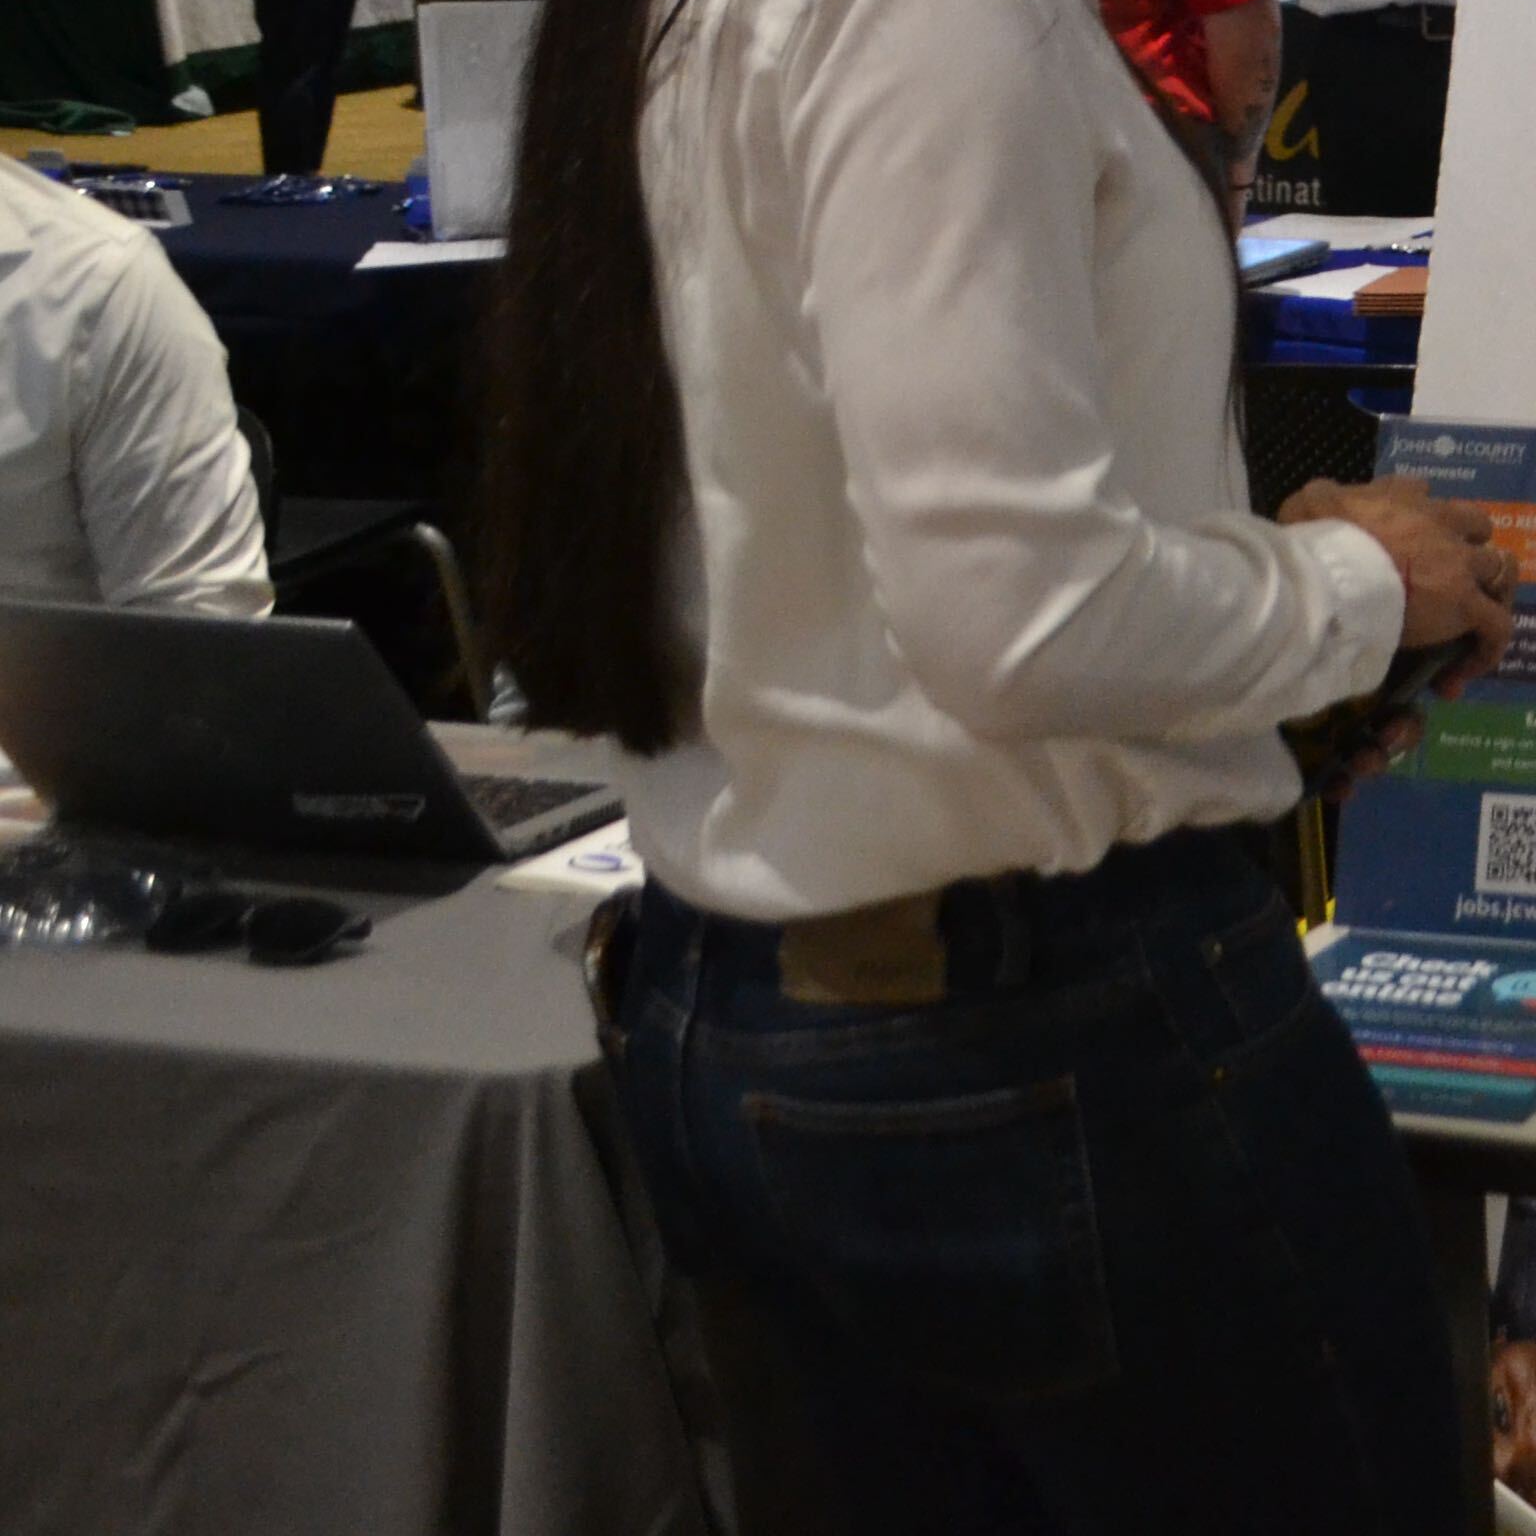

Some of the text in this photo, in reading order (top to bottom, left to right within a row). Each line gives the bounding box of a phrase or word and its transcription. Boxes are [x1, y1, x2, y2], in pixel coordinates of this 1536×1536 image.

[1361, 951, 1499, 978] Check
[1320, 981, 1465, 1007] online
[1399, 970, 1479, 993] out
